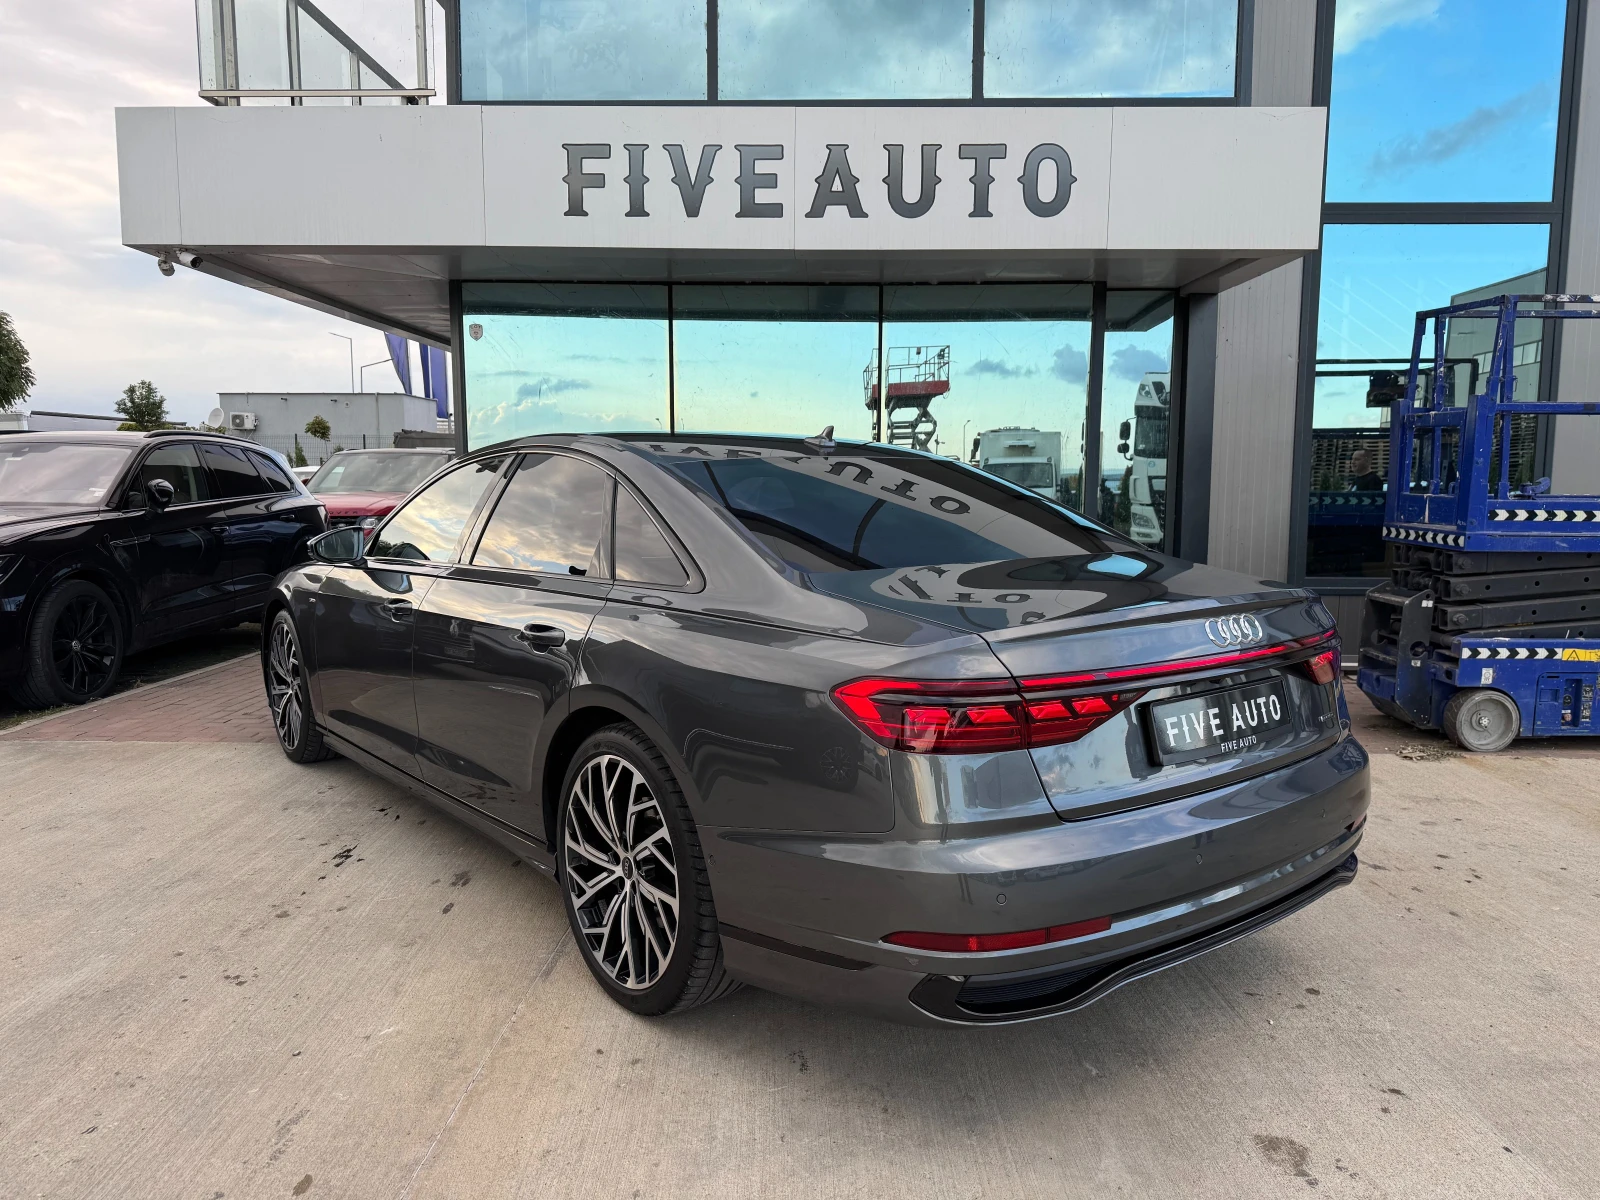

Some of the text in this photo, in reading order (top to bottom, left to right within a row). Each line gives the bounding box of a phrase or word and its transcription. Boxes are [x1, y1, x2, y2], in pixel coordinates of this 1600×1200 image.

[1164, 694, 1281, 747] FIVE AUTO
[1221, 735, 1257, 753] FIVE AUTO
